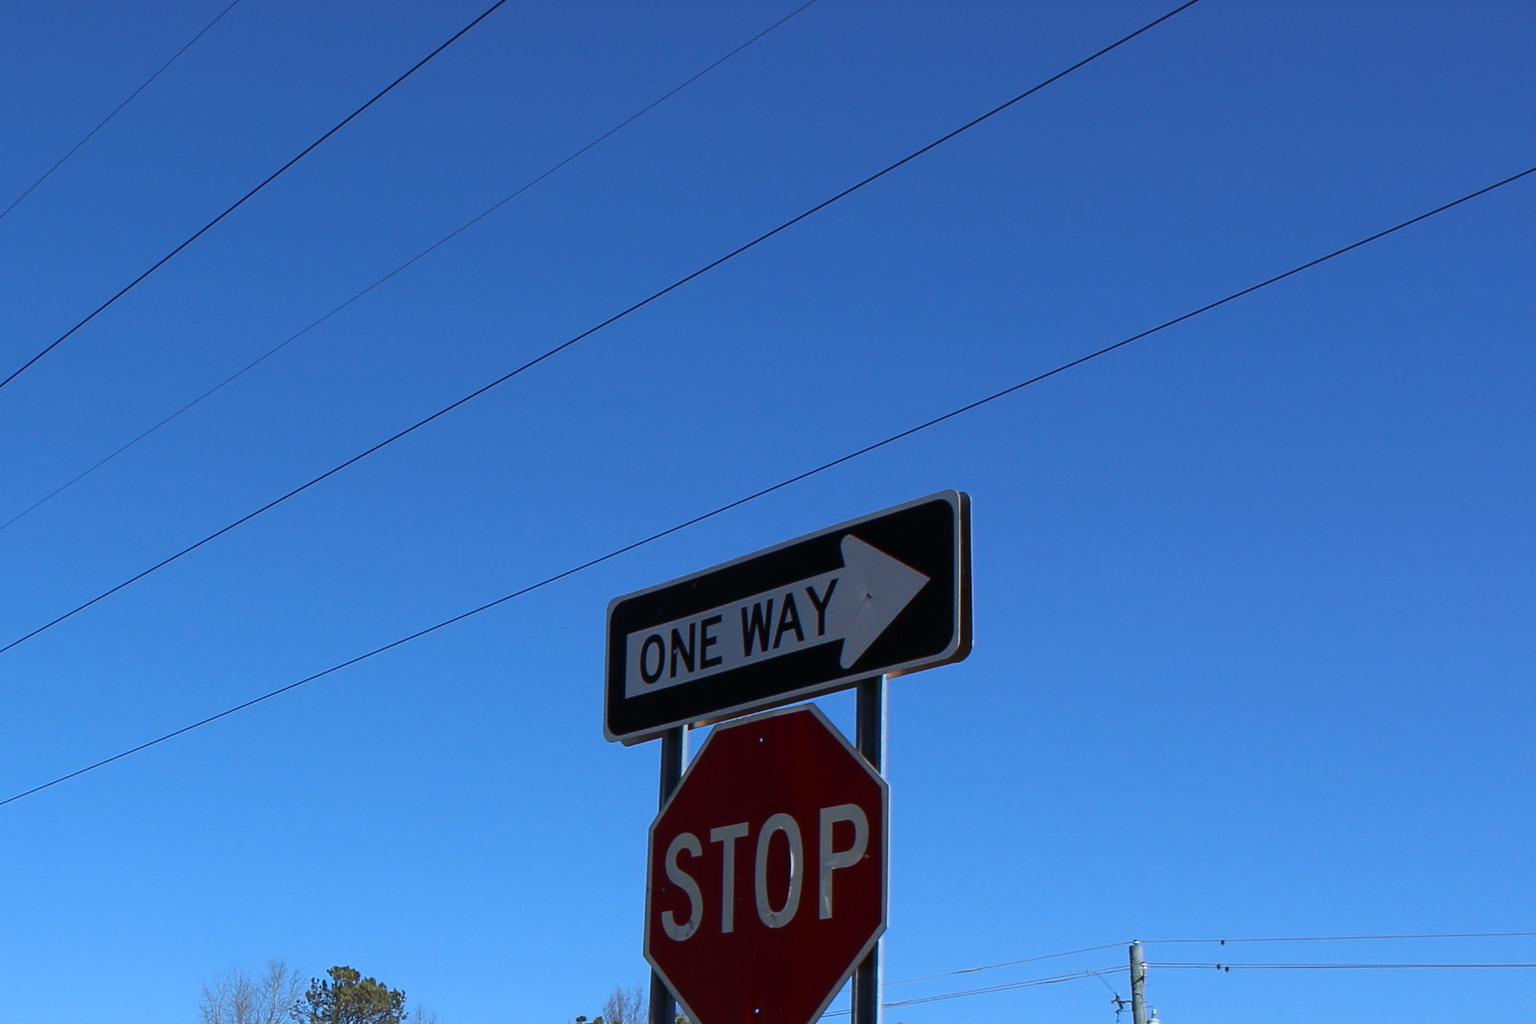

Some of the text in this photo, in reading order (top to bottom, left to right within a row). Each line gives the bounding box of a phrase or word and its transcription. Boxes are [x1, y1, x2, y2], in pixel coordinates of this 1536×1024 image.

[639, 578, 839, 685] ONE WAY
[661, 803, 869, 942] STOP
